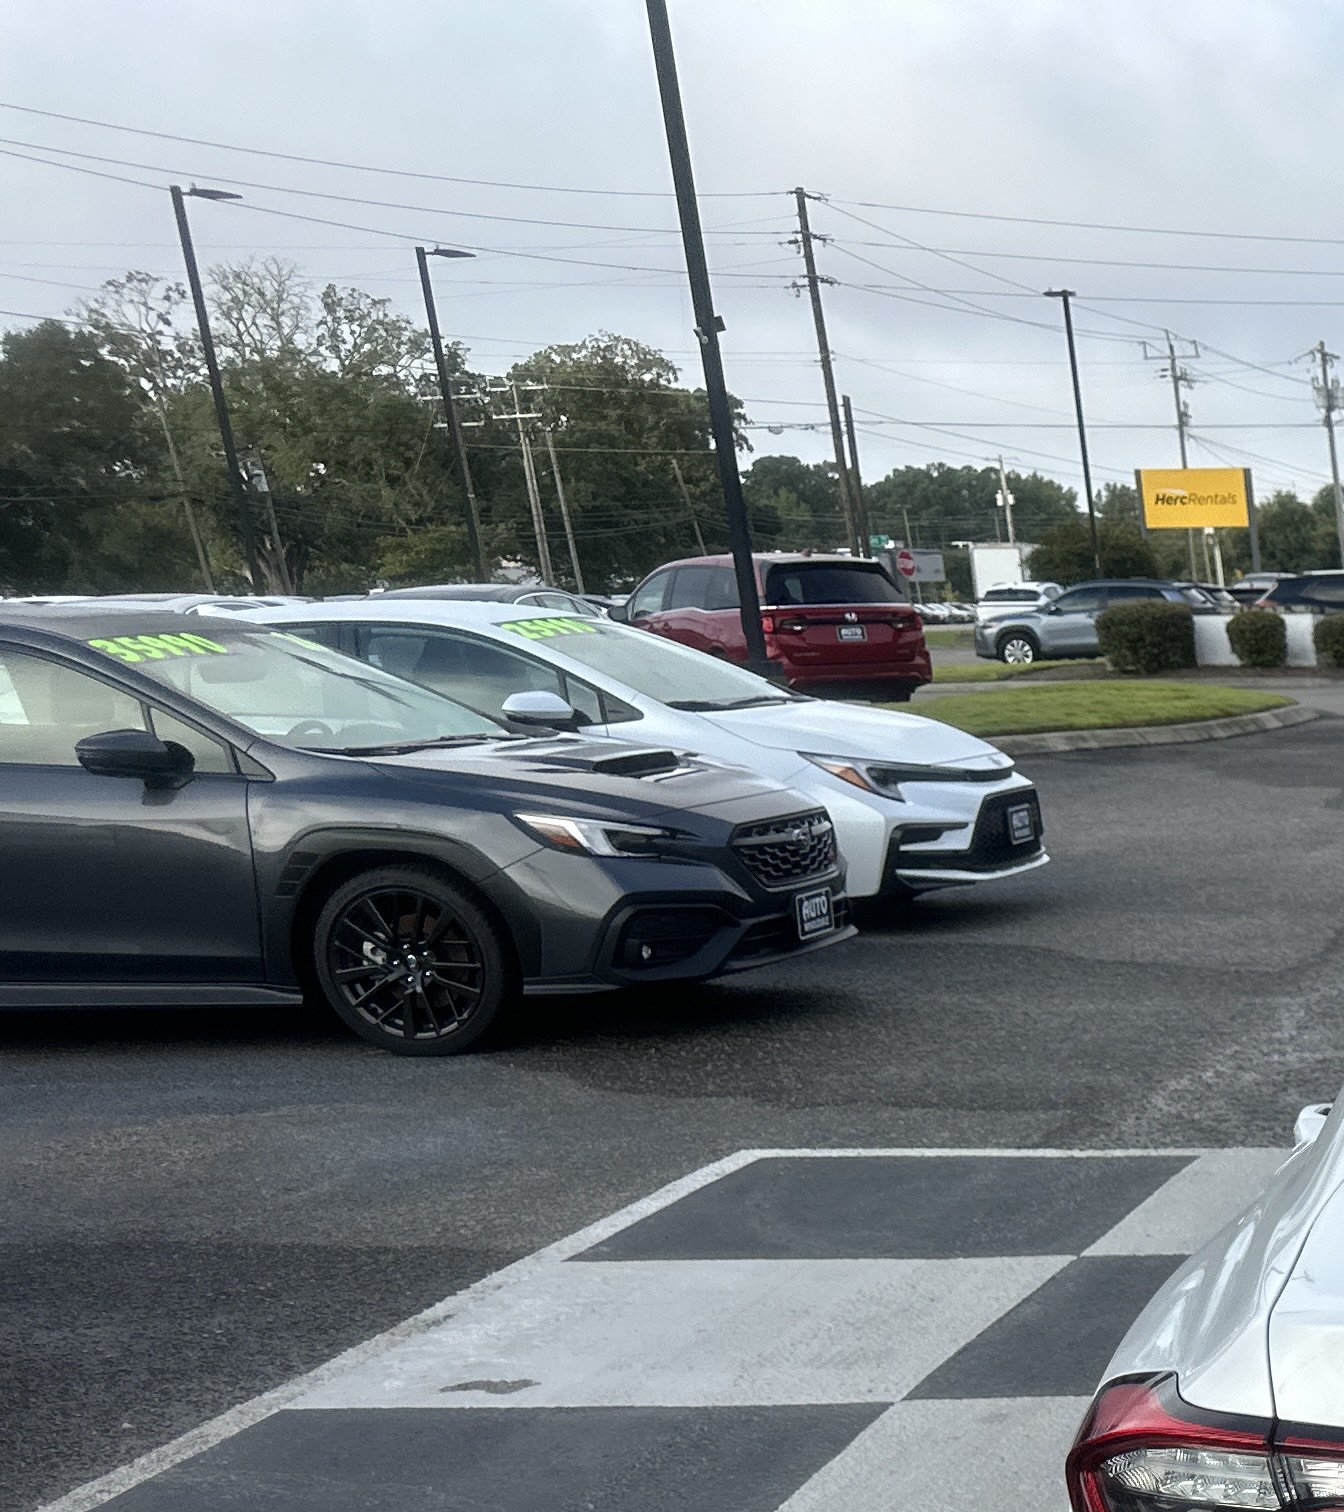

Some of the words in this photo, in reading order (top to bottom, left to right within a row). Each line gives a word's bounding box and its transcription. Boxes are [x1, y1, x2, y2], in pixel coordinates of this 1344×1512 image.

[1154, 493, 1238, 506] HercRentals
[88, 632, 228, 662] 35990
[802, 895, 828, 921] AUTO
